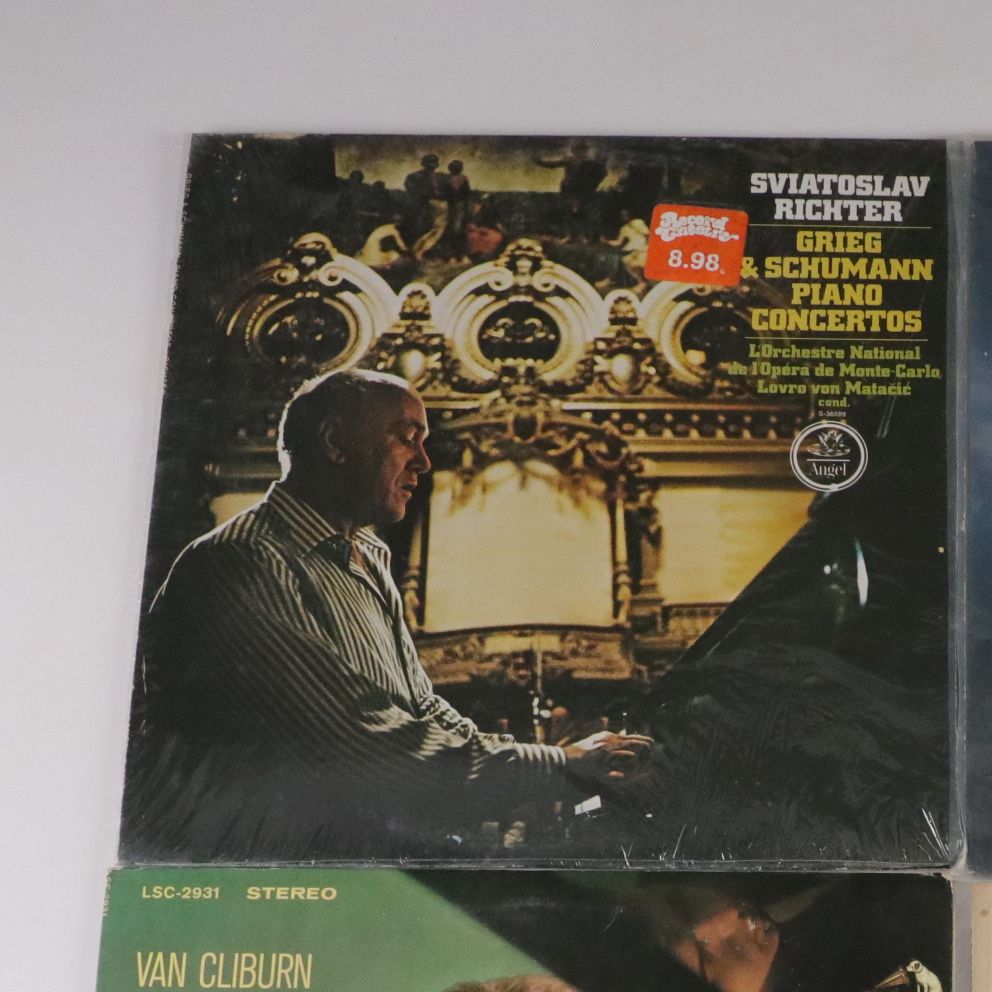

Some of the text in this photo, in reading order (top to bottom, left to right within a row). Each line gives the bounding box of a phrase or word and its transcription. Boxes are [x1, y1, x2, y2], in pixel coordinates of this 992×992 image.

[750, 172, 930, 197] SVIATOSLAV
[774, 198, 903, 222] RICHTER
[796, 230, 882, 254] GRIEG
[668, 249, 720, 272] 8.98
[740, 256, 934, 280] & SCHUMANN
[790, 282, 882, 306] PIANO
[750, 308, 922, 332] CONCERTOS
[748, 344, 921, 360] L'Orchestre National
[814, 362, 834, 376] de
[757, 379, 807, 394] Lovro
[810, 384, 840, 395] von
[818, 398, 850, 408] cond.
[808, 462, 848, 478] Angel
[141, 886, 337, 900] LSC-2931 STEREO
[136, 951, 312, 990] VAN CLIBURN
